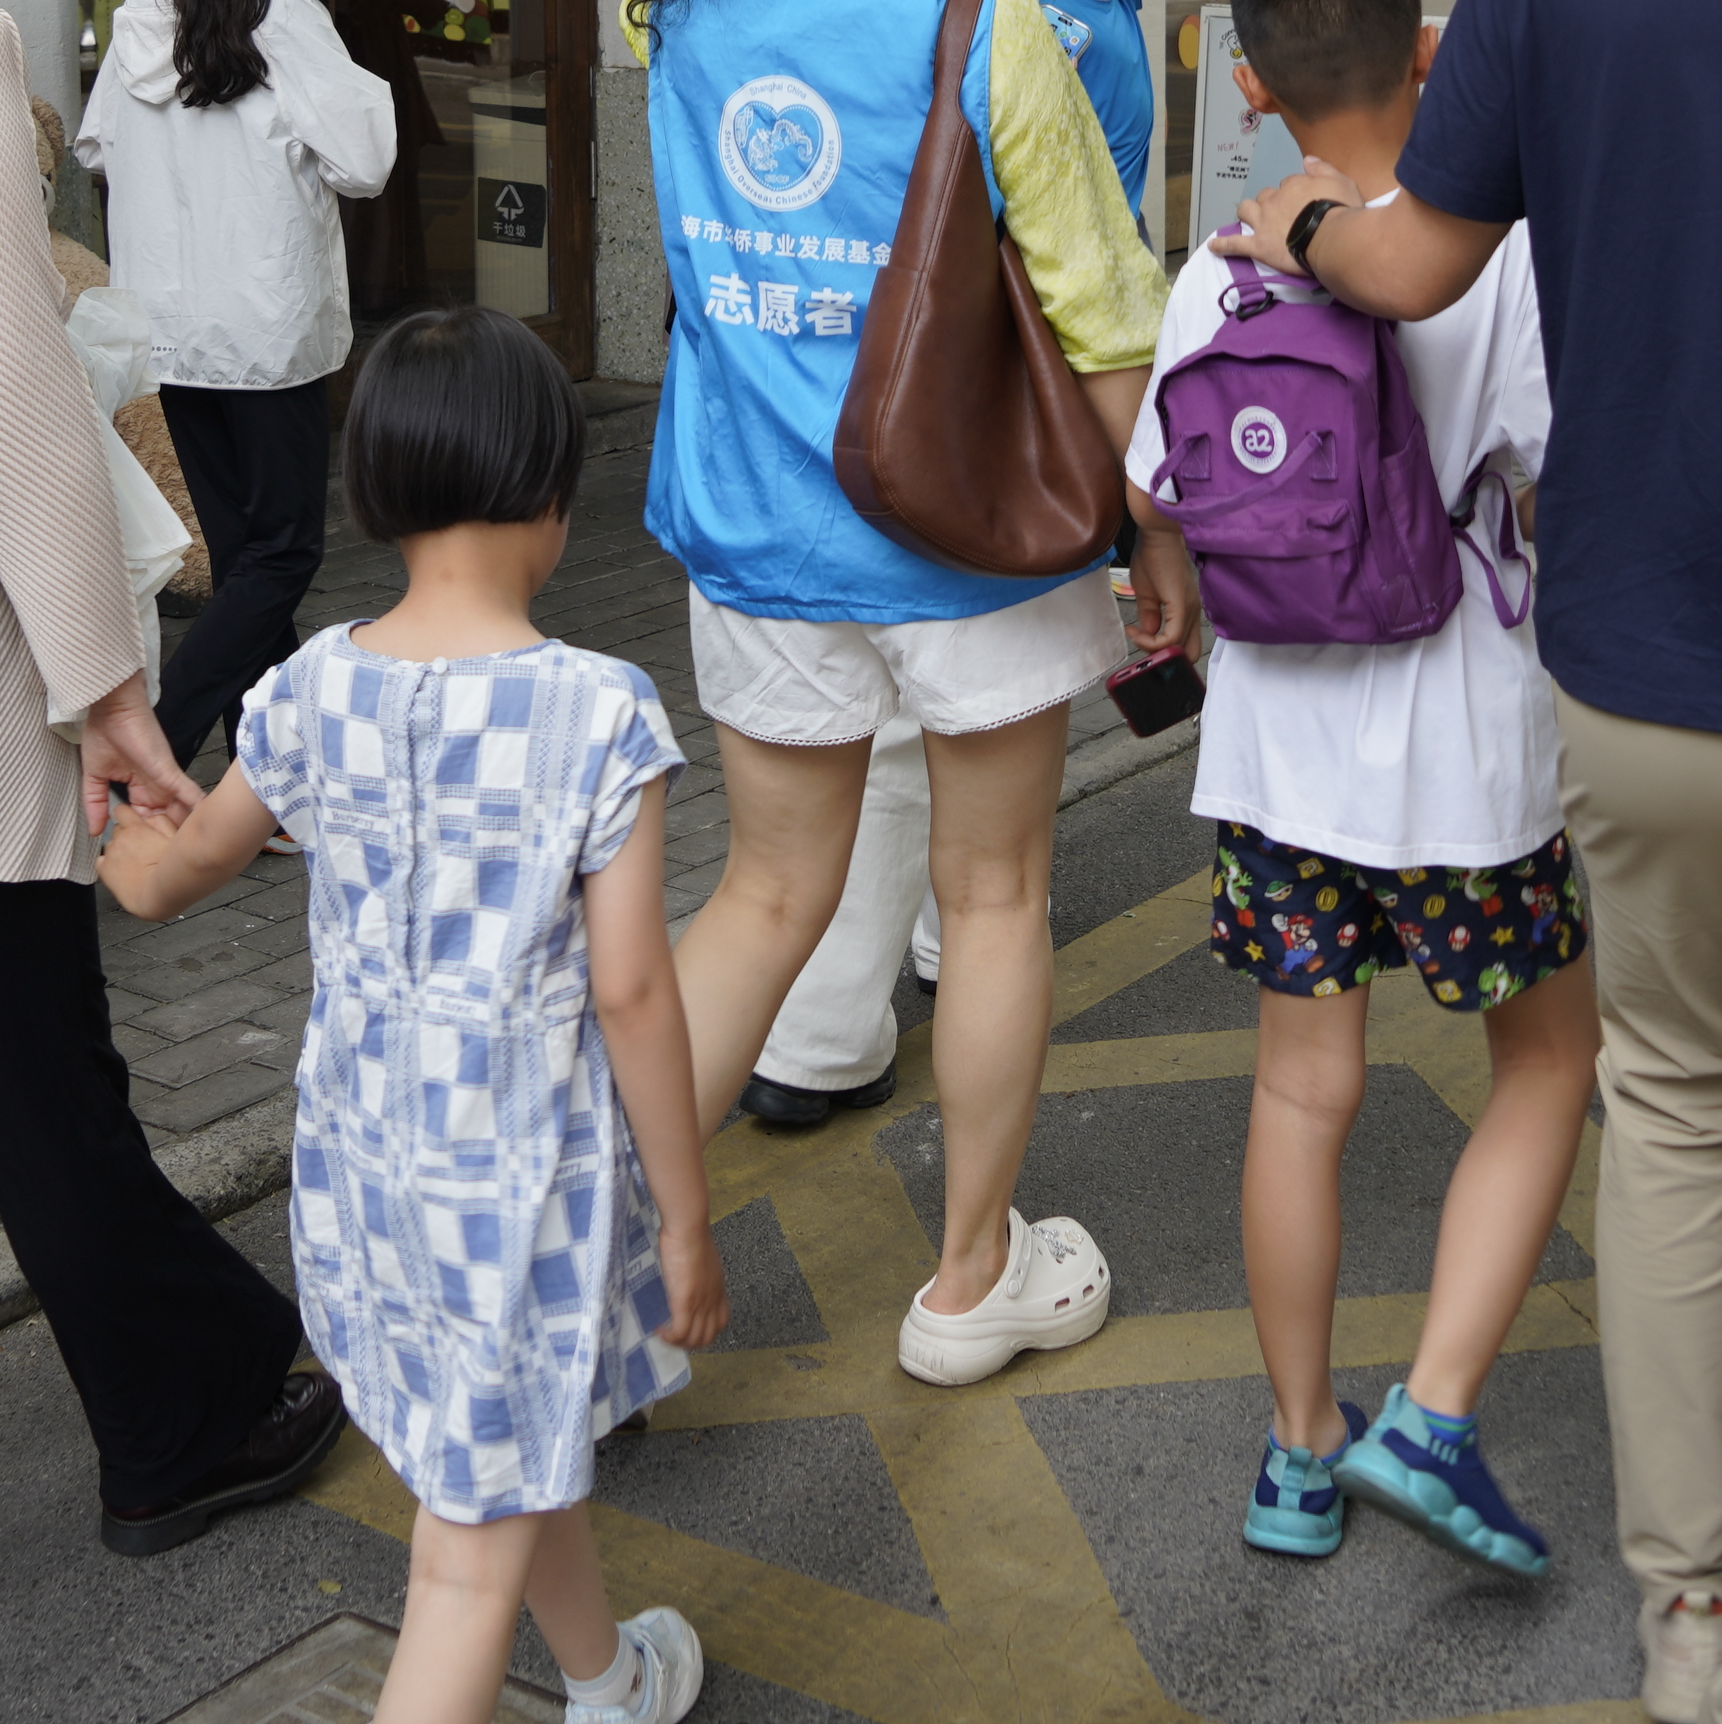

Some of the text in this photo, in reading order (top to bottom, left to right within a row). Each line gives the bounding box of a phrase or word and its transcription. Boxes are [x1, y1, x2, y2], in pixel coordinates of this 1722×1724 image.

[749, 82, 807, 100] Shanghai China
[1217, 141, 1239, 152] NEW!
[724, 129, 738, 175] Shanghai
[775, 188, 814, 205] Chinese
[812, 139, 835, 191] Foundation
[492, 221, 527, 238] 干垃圾
[704, 272, 857, 338] 志愿者
[1245, 428, 1272, 453] a2
